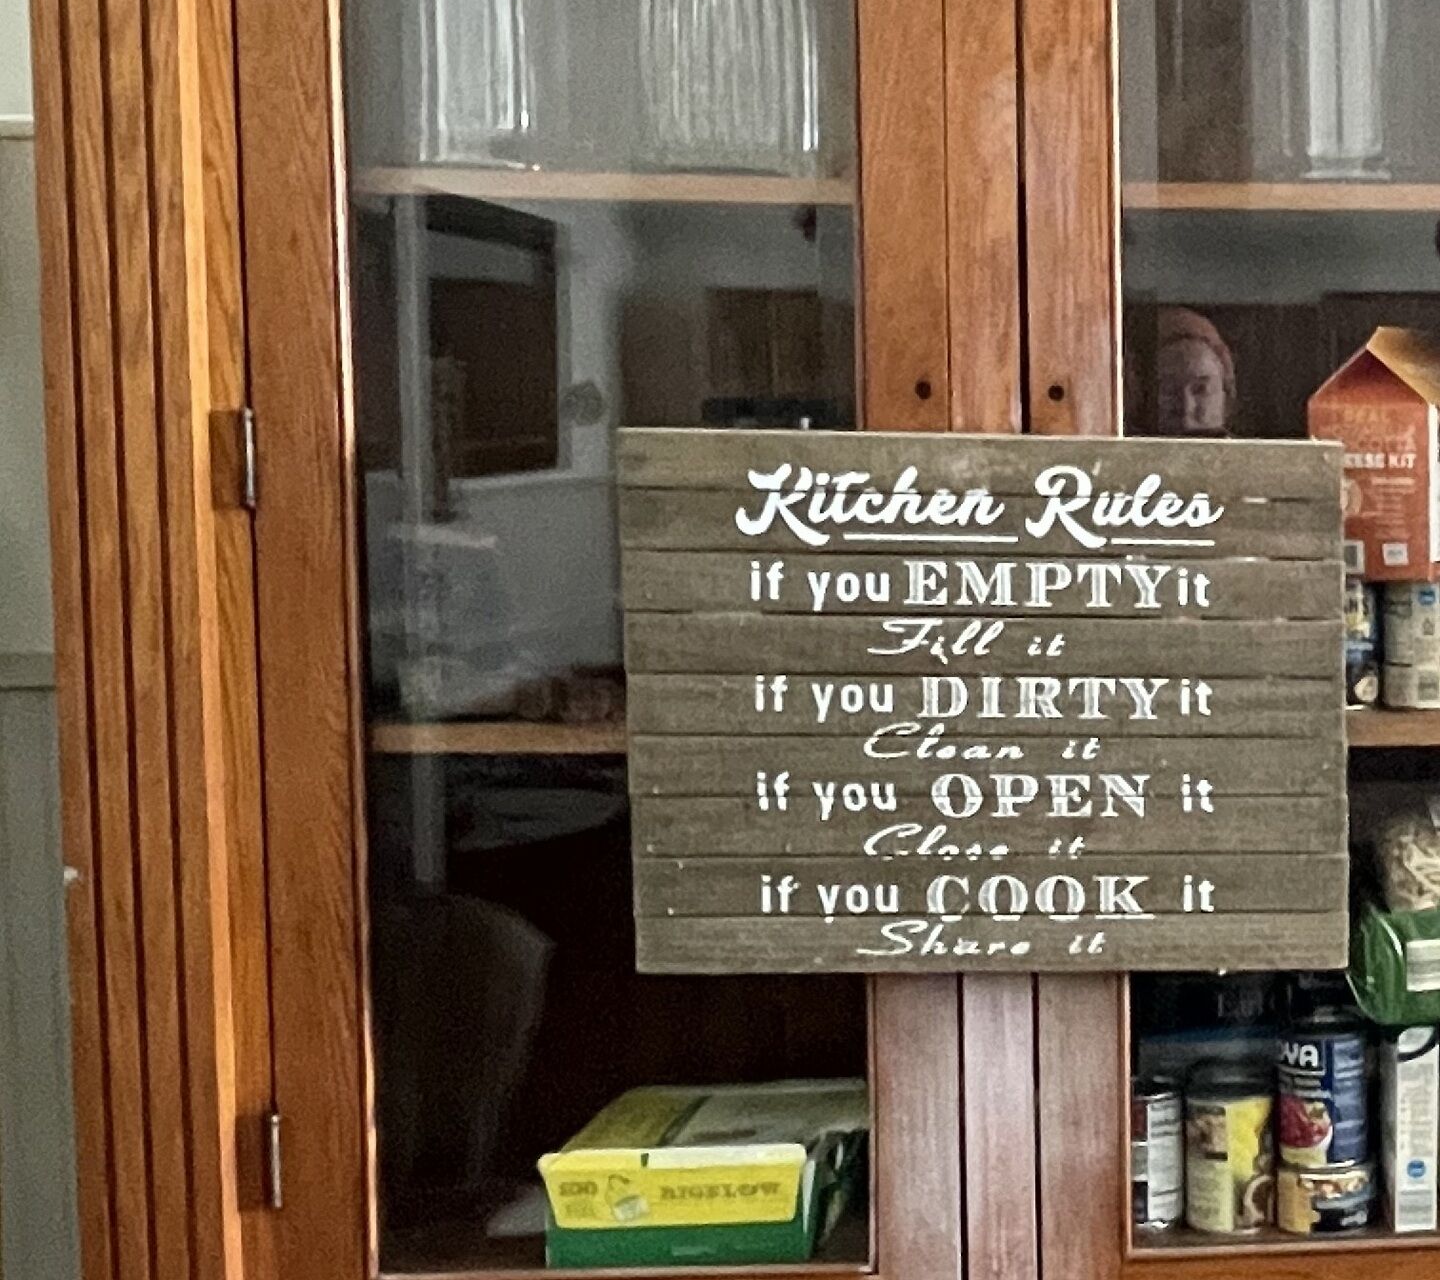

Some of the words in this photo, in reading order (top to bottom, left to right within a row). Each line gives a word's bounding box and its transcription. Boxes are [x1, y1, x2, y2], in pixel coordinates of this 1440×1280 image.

[734, 462, 1005, 547] Kitchen
[1024, 463, 1226, 549] Rules
[749, 559, 785, 603] if
[806, 570, 891, 613] you
[902, 559, 1173, 609] EMPTY
[1175, 566, 1212, 609] it
[866, 616, 1006, 666] Fill
[1026, 632, 1066, 658] it
[754, 674, 789, 713] if
[810, 682, 896, 726] you
[915, 675, 1171, 721] DIRTY
[1178, 677, 1214, 717] it
[1060, 736, 1102, 761] it
[755, 770, 791, 812] if
[811, 780, 898, 822] you
[930, 772, 1152, 820] OPEN
[1180, 772, 1216, 814] it
[862, 822, 1011, 862] Close
[1047, 835, 1087, 861] it
[760, 873, 800, 914] if
[816, 883, 904, 927] you
[925, 873, 1158, 924] COOK
[1182, 874, 1216, 913] it
[1067, 930, 1107, 955] it
